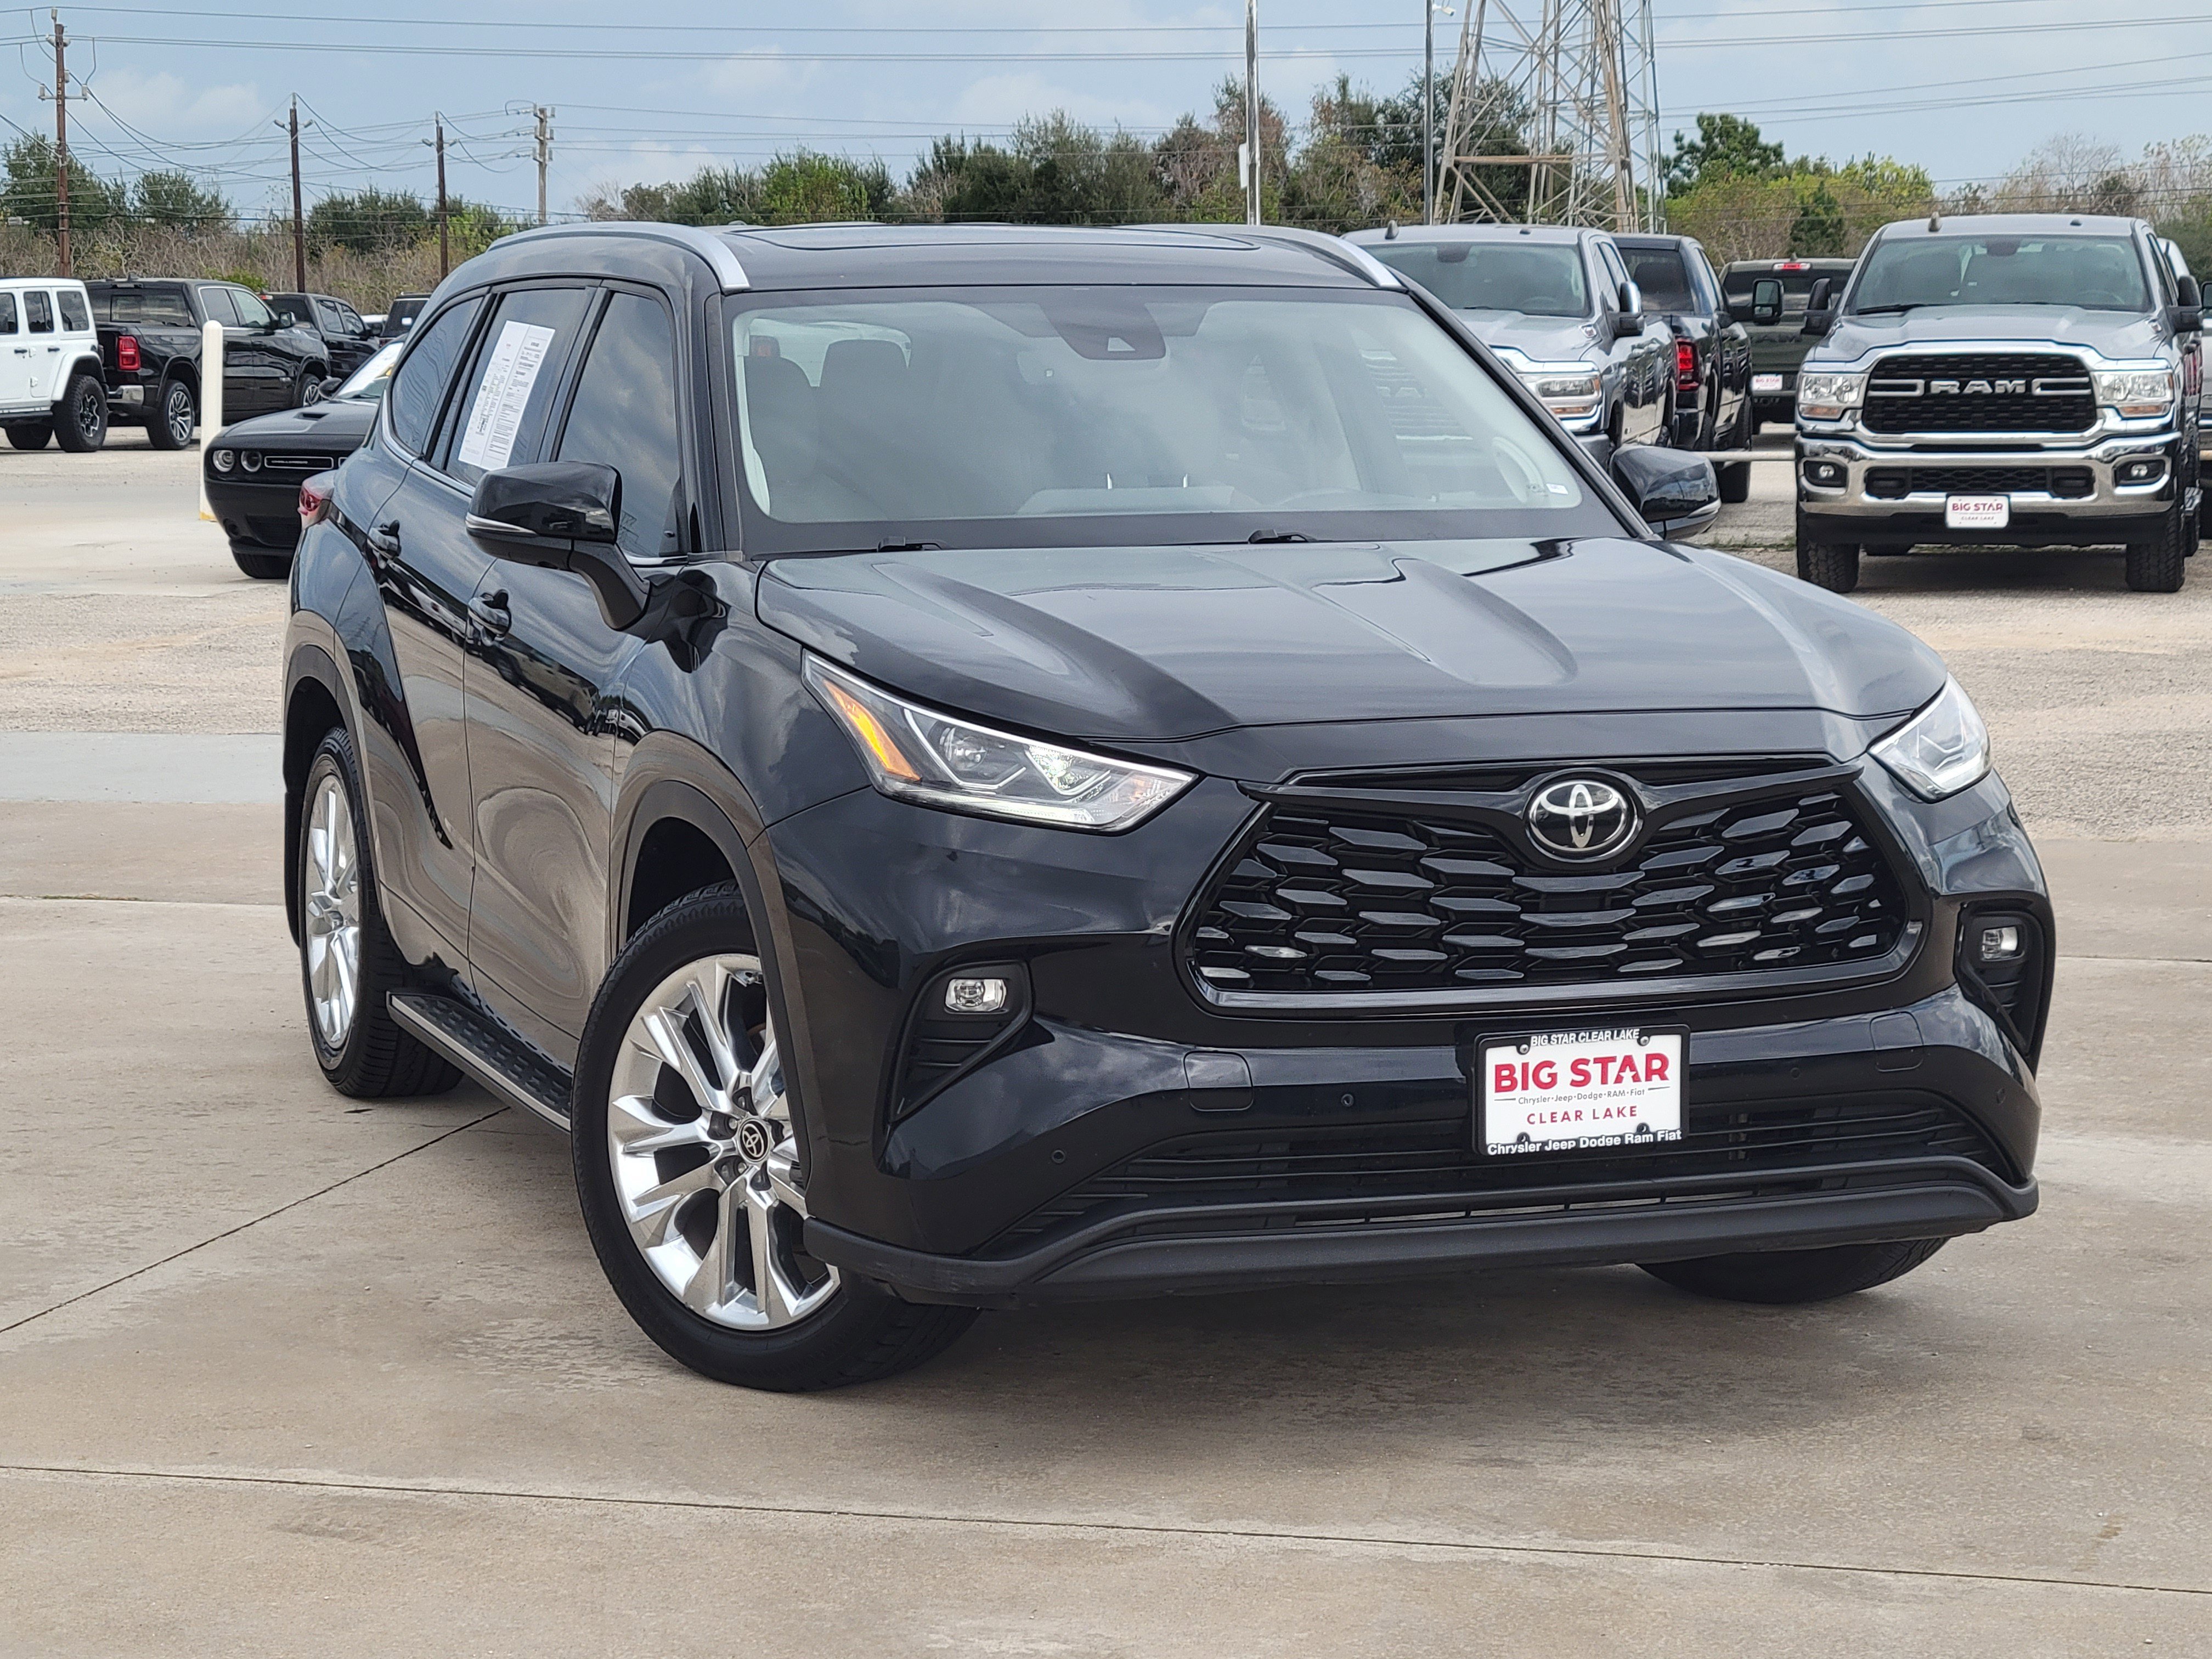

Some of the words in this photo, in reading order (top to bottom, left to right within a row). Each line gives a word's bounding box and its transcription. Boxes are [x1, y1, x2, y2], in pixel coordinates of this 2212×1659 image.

[1930, 380, 2026, 394] RAM
[1952, 503, 1971, 511] BIG
[1973, 503, 2003, 511] STAR
[1530, 1034, 1548, 1047] BIG
[1550, 1032, 1576, 1045] STAR
[1577, 1030, 1611, 1043] CLEAR
[1612, 1028, 1640, 1040] LAKE
[1494, 1060, 1558, 1093] BIG
[1569, 1052, 1669, 1087] STAR
[1518, 1095, 1550, 1106] Chrysler
[1554, 1093, 1573, 1102] Jeep
[1577, 1091, 1603, 1100] Dodge
[1607, 1090, 1626, 1098] RAM
[1630, 1088, 1645, 1097] Fiat
[1527, 1109, 1584, 1125] CLEAR
[1592, 1105, 1638, 1120] LAKE
[1487, 1142, 1543, 1156] Chrysler
[1544, 1139, 1577, 1152] Jeep
[1579, 1135, 1622, 1148] Dodge
[1624, 1131, 1654, 1144] Ram
[1656, 1129, 1683, 1142] Fiat
